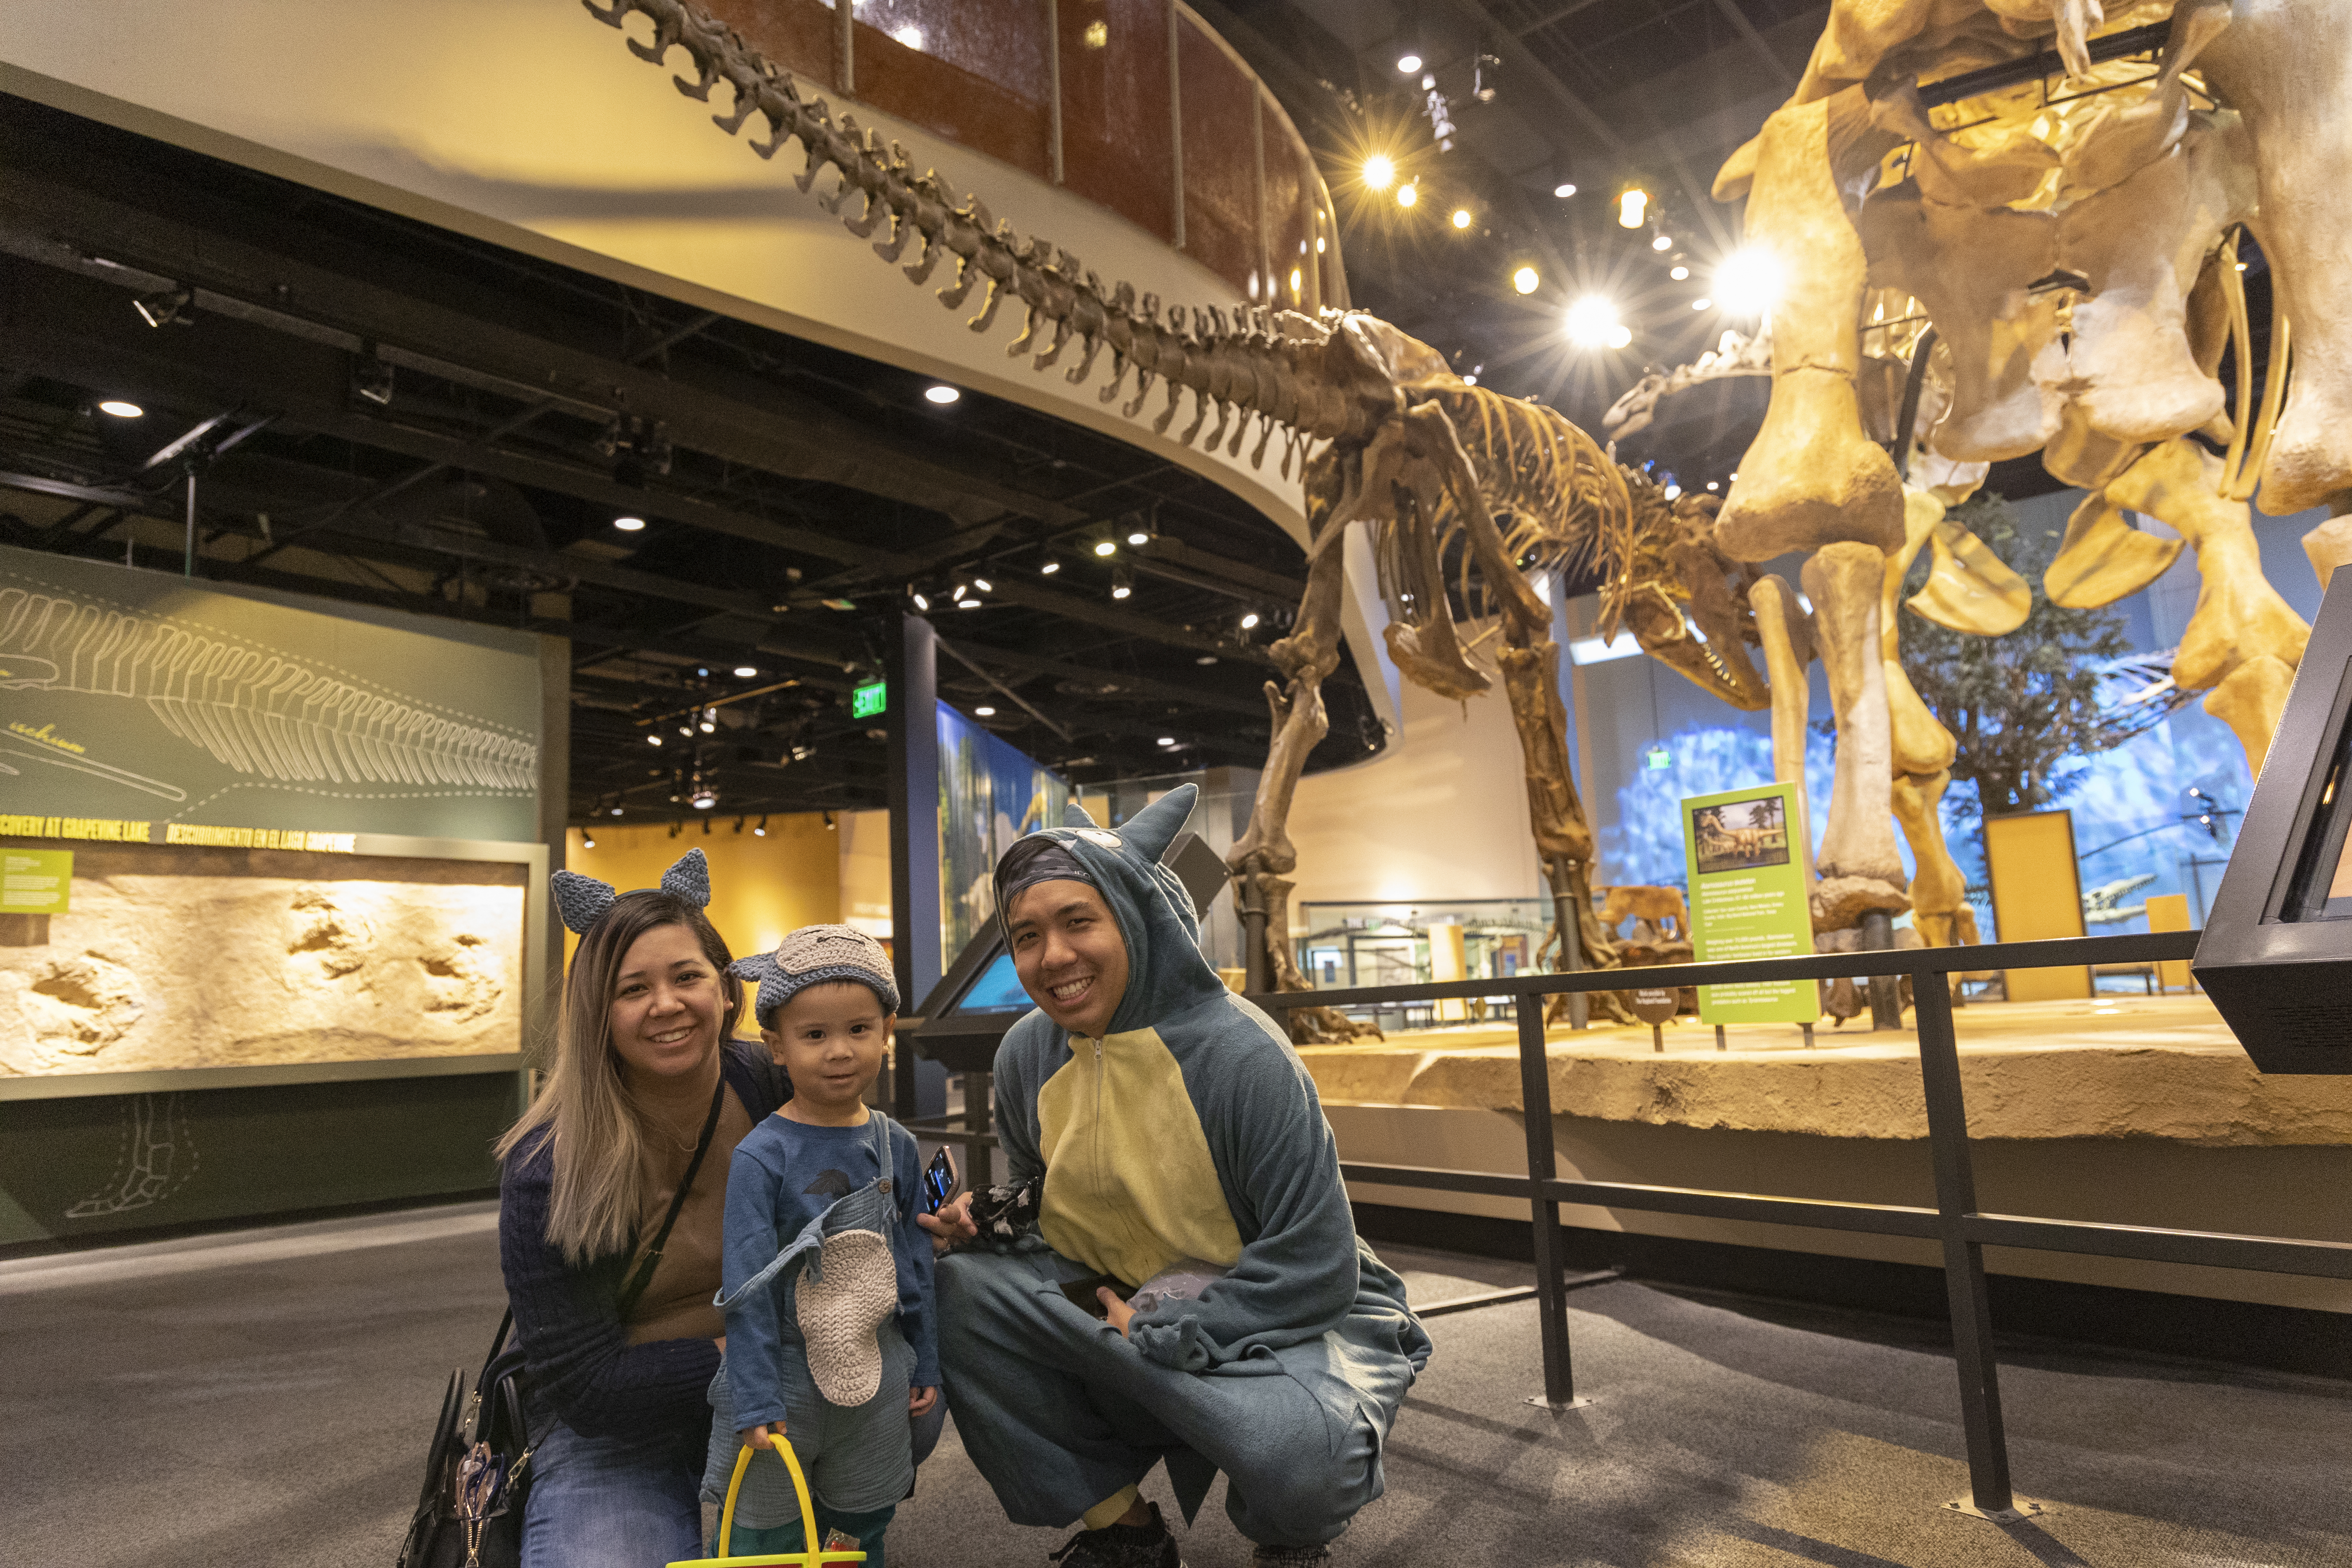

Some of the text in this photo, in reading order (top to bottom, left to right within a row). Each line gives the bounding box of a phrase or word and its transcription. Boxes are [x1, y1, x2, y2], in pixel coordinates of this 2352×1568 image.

[45, 817, 61, 838] AT
[62, 817, 122, 841] GRAPEVINE
[122, 821, 151, 842] LAKE
[165, 823, 254, 848] DESCUBRIMIENTO
[305, 831, 356, 853] GRAPEVINE
